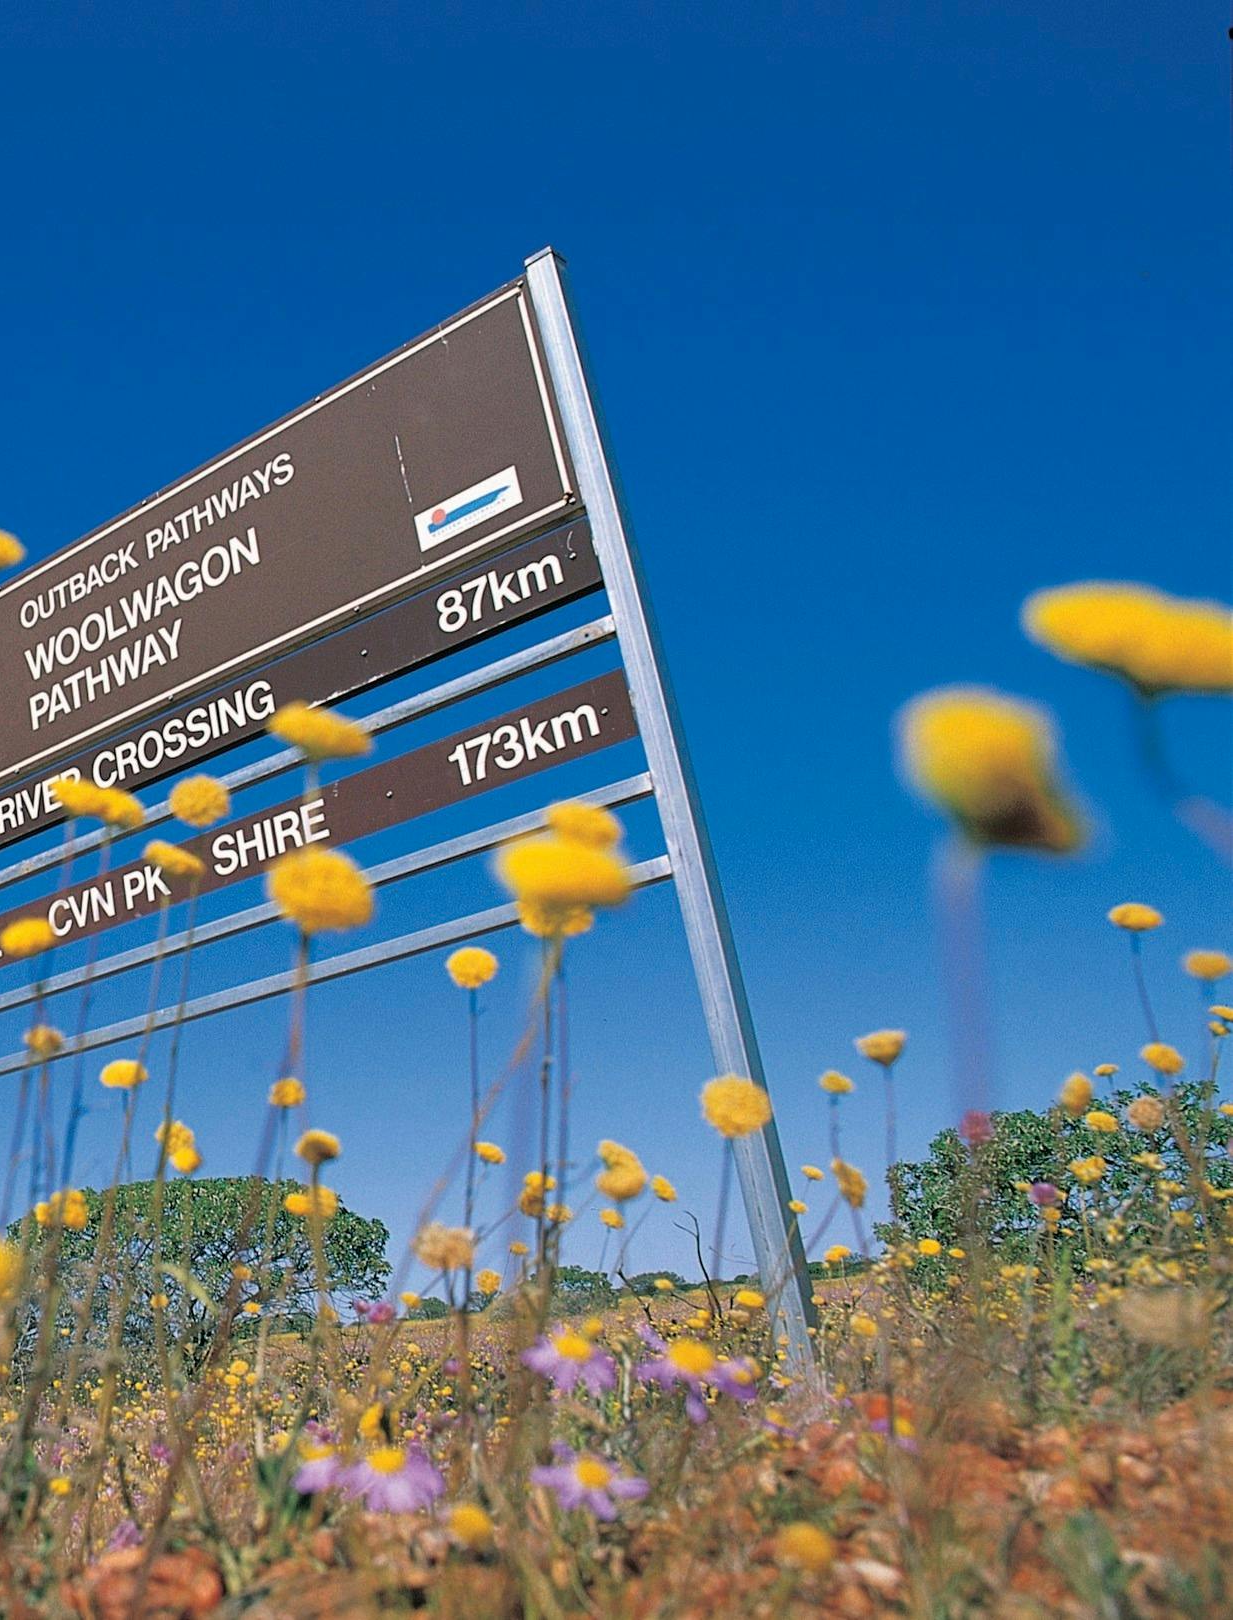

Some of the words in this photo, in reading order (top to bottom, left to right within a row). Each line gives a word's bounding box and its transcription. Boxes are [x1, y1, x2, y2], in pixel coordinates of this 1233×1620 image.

[19, 541, 140, 629] OUTBACK
[145, 452, 295, 560] PATHWAYS
[23, 527, 261, 681] WOOLWAGON
[29, 618, 183, 731] PATHWAY
[92, 680, 276, 788] CROSSING
[436, 554, 564, 633] 87km
[48, 881, 116, 937] CVN
[123, 865, 172, 910] PK
[212, 798, 330, 876] SHIRE
[448, 703, 600, 786] 173km
